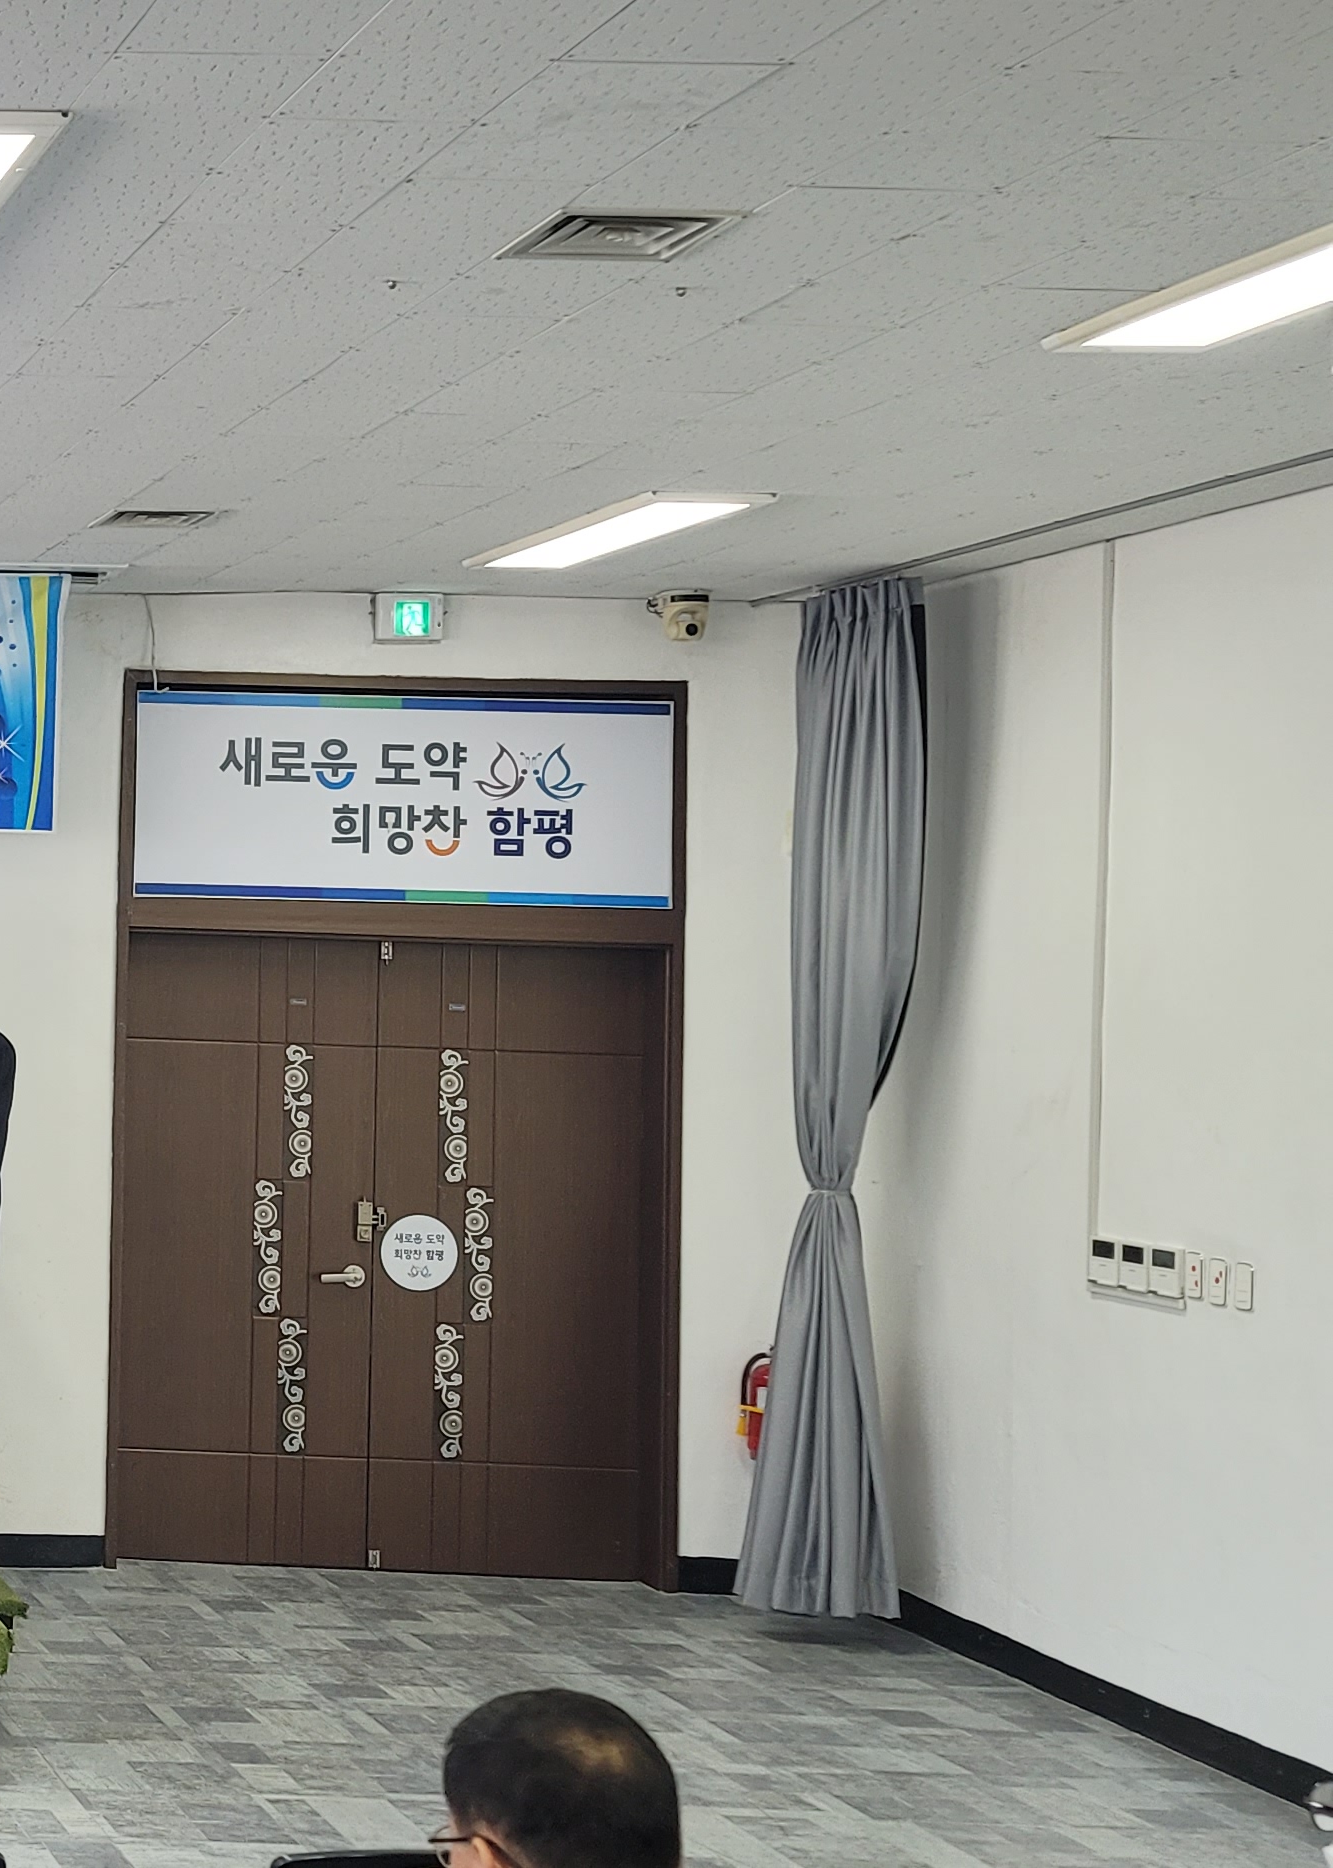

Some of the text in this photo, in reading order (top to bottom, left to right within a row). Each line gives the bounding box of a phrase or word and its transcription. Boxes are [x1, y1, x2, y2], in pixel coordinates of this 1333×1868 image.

[219, 737, 467, 791] 새로운 도약
[331, 804, 575, 859] 희망찬 함평
[425, 1233, 445, 1245] 도약
